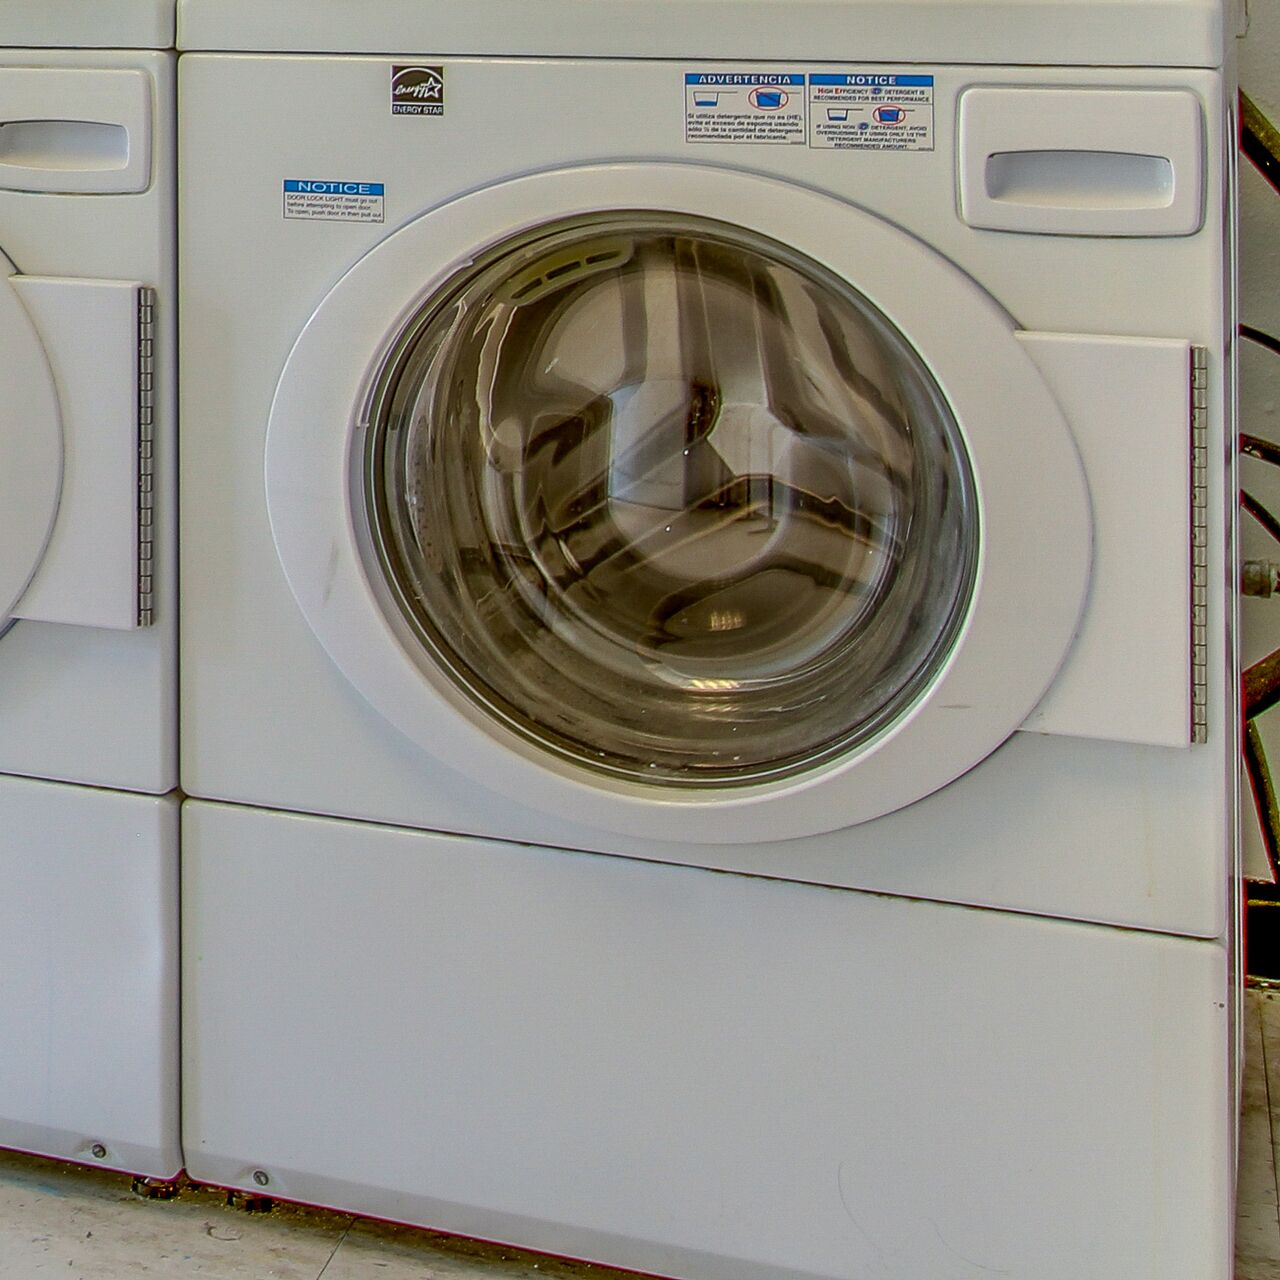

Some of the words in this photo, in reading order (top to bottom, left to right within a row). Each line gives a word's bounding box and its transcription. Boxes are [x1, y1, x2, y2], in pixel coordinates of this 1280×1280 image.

[699, 75, 790, 84] ADVERTENCIA
[847, 76, 896, 85] NOTICE
[393, 105, 422, 114] ENERGY
[423, 106, 443, 114] STAR
[298, 182, 370, 193] NOTICE
